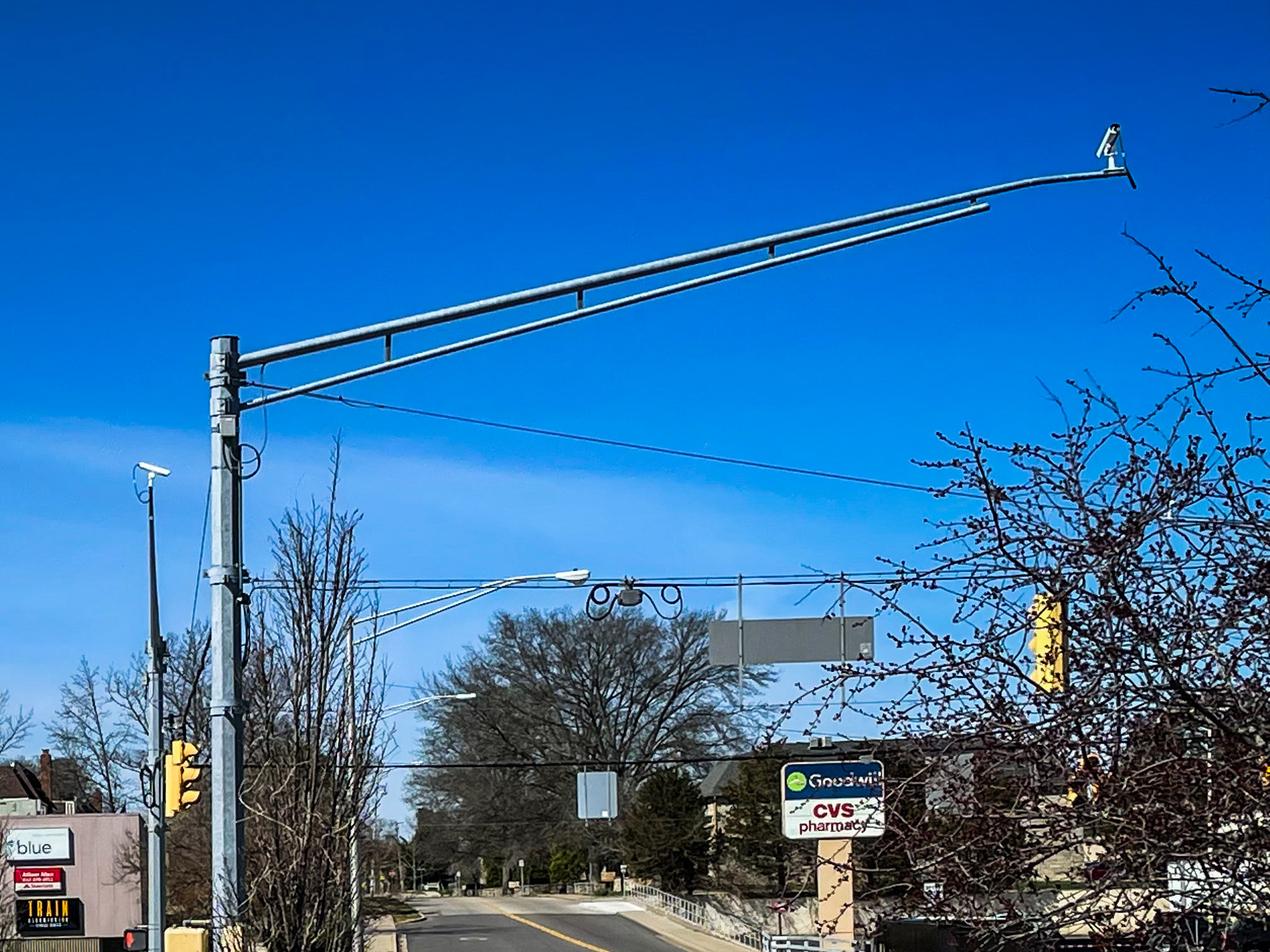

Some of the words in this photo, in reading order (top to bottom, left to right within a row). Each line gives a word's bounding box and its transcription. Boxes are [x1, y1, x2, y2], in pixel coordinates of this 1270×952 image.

[813, 803, 854, 818] CVS
[799, 820, 868, 835] pharmacy
[17, 840, 52, 855] blue
[28, 900, 69, 917] TRAIN
